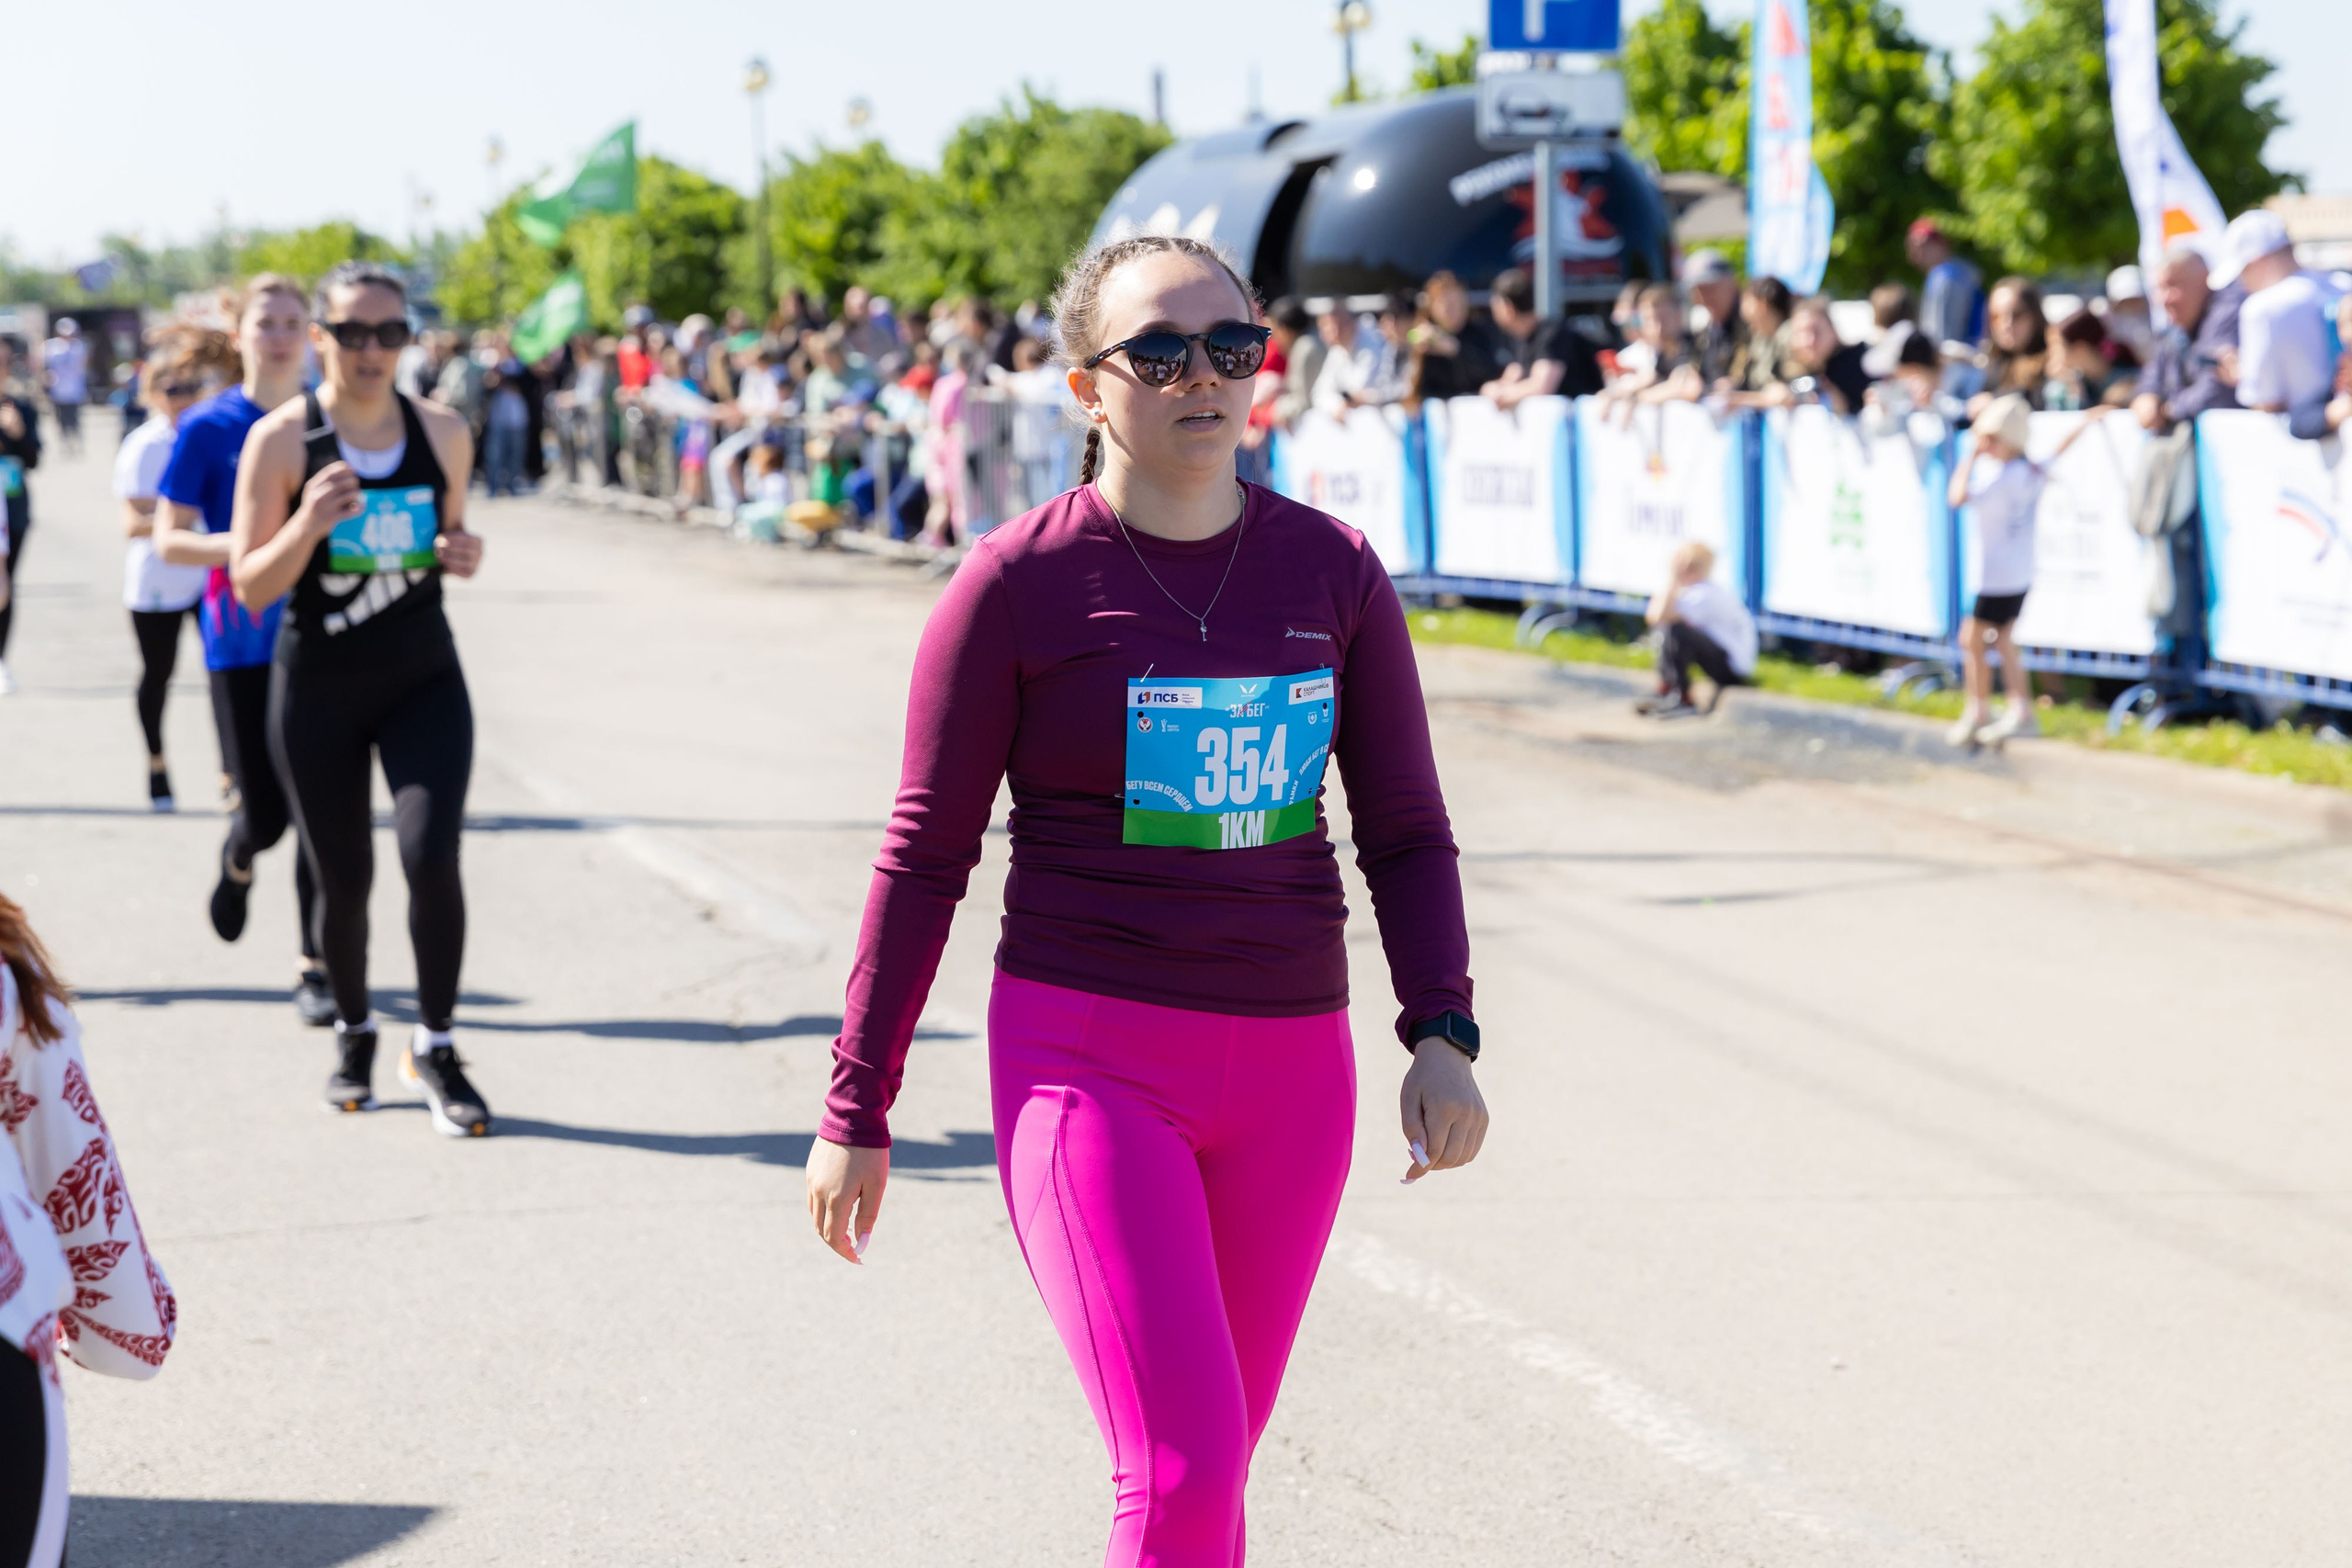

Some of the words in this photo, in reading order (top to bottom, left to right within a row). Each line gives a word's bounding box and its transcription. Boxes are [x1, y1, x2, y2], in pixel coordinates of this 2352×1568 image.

[1295, 631, 1331, 641] DEMIX
[1154, 693, 1179, 703] ПСБ
[1194, 724, 1289, 807] 354
[1125, 780, 1144, 790] БЕГУ
[1144, 780, 1164, 794] ВСЕМ
[1162, 784, 1193, 813] СЕРДЦЕМ
